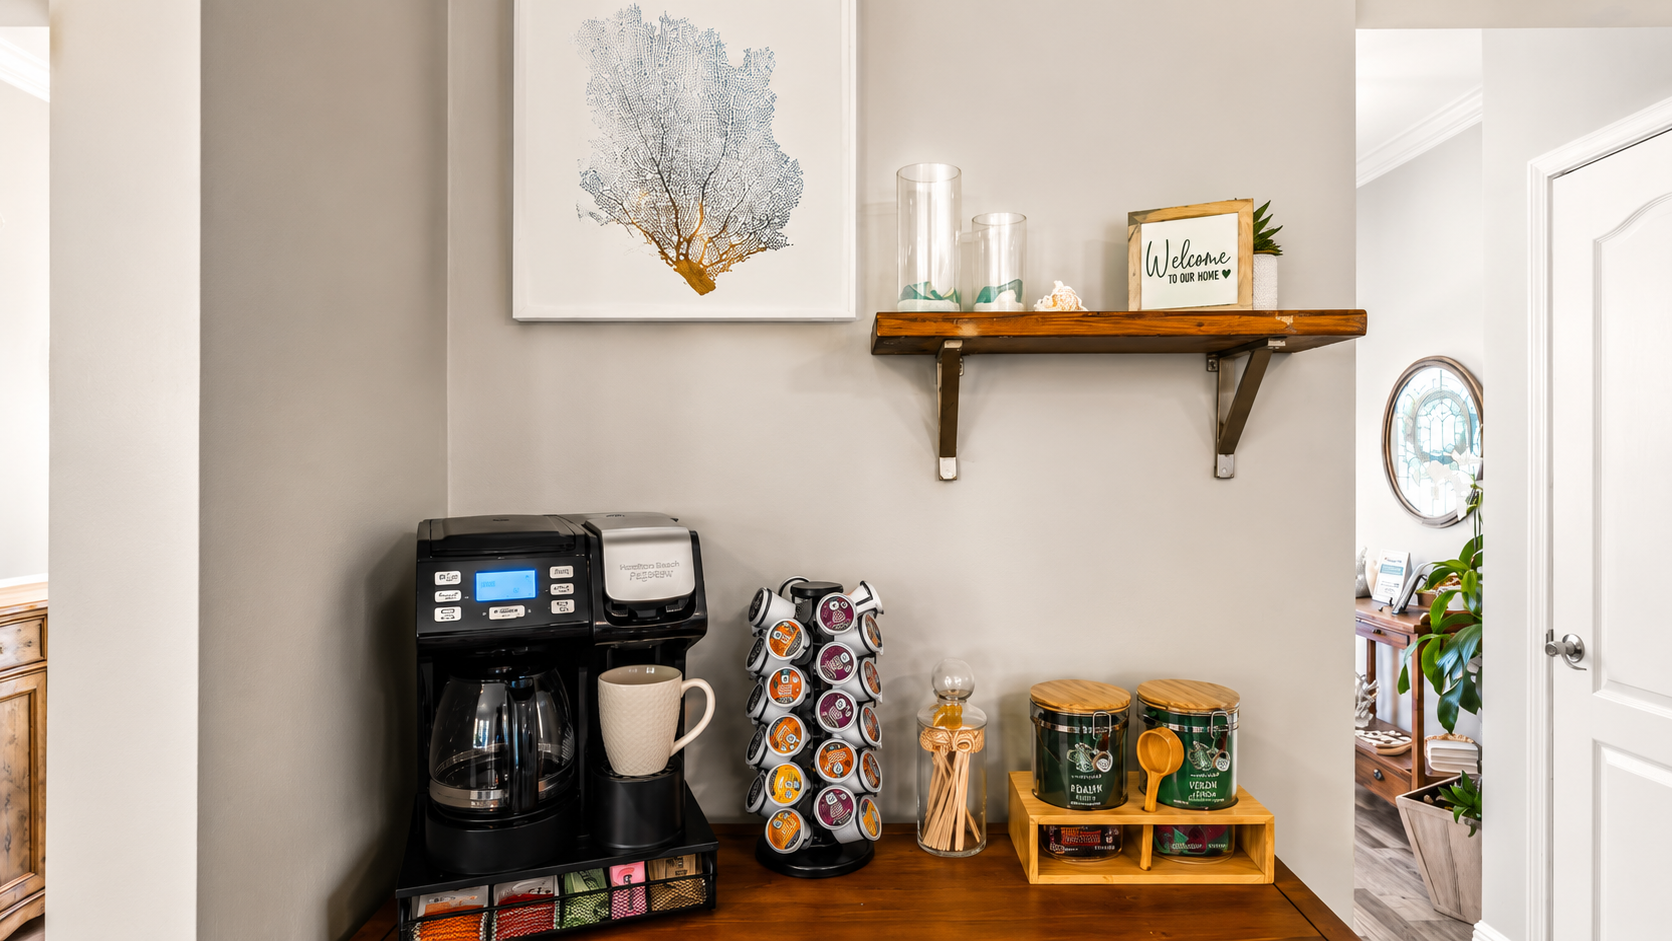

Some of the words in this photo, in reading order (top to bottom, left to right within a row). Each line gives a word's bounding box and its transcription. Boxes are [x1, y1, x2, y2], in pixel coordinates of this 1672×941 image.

[1146, 239, 1231, 278] Welcome
[1168, 274, 1178, 284] TO
[1180, 272, 1195, 283] OUR
[1198, 270, 1219, 282] HOME
